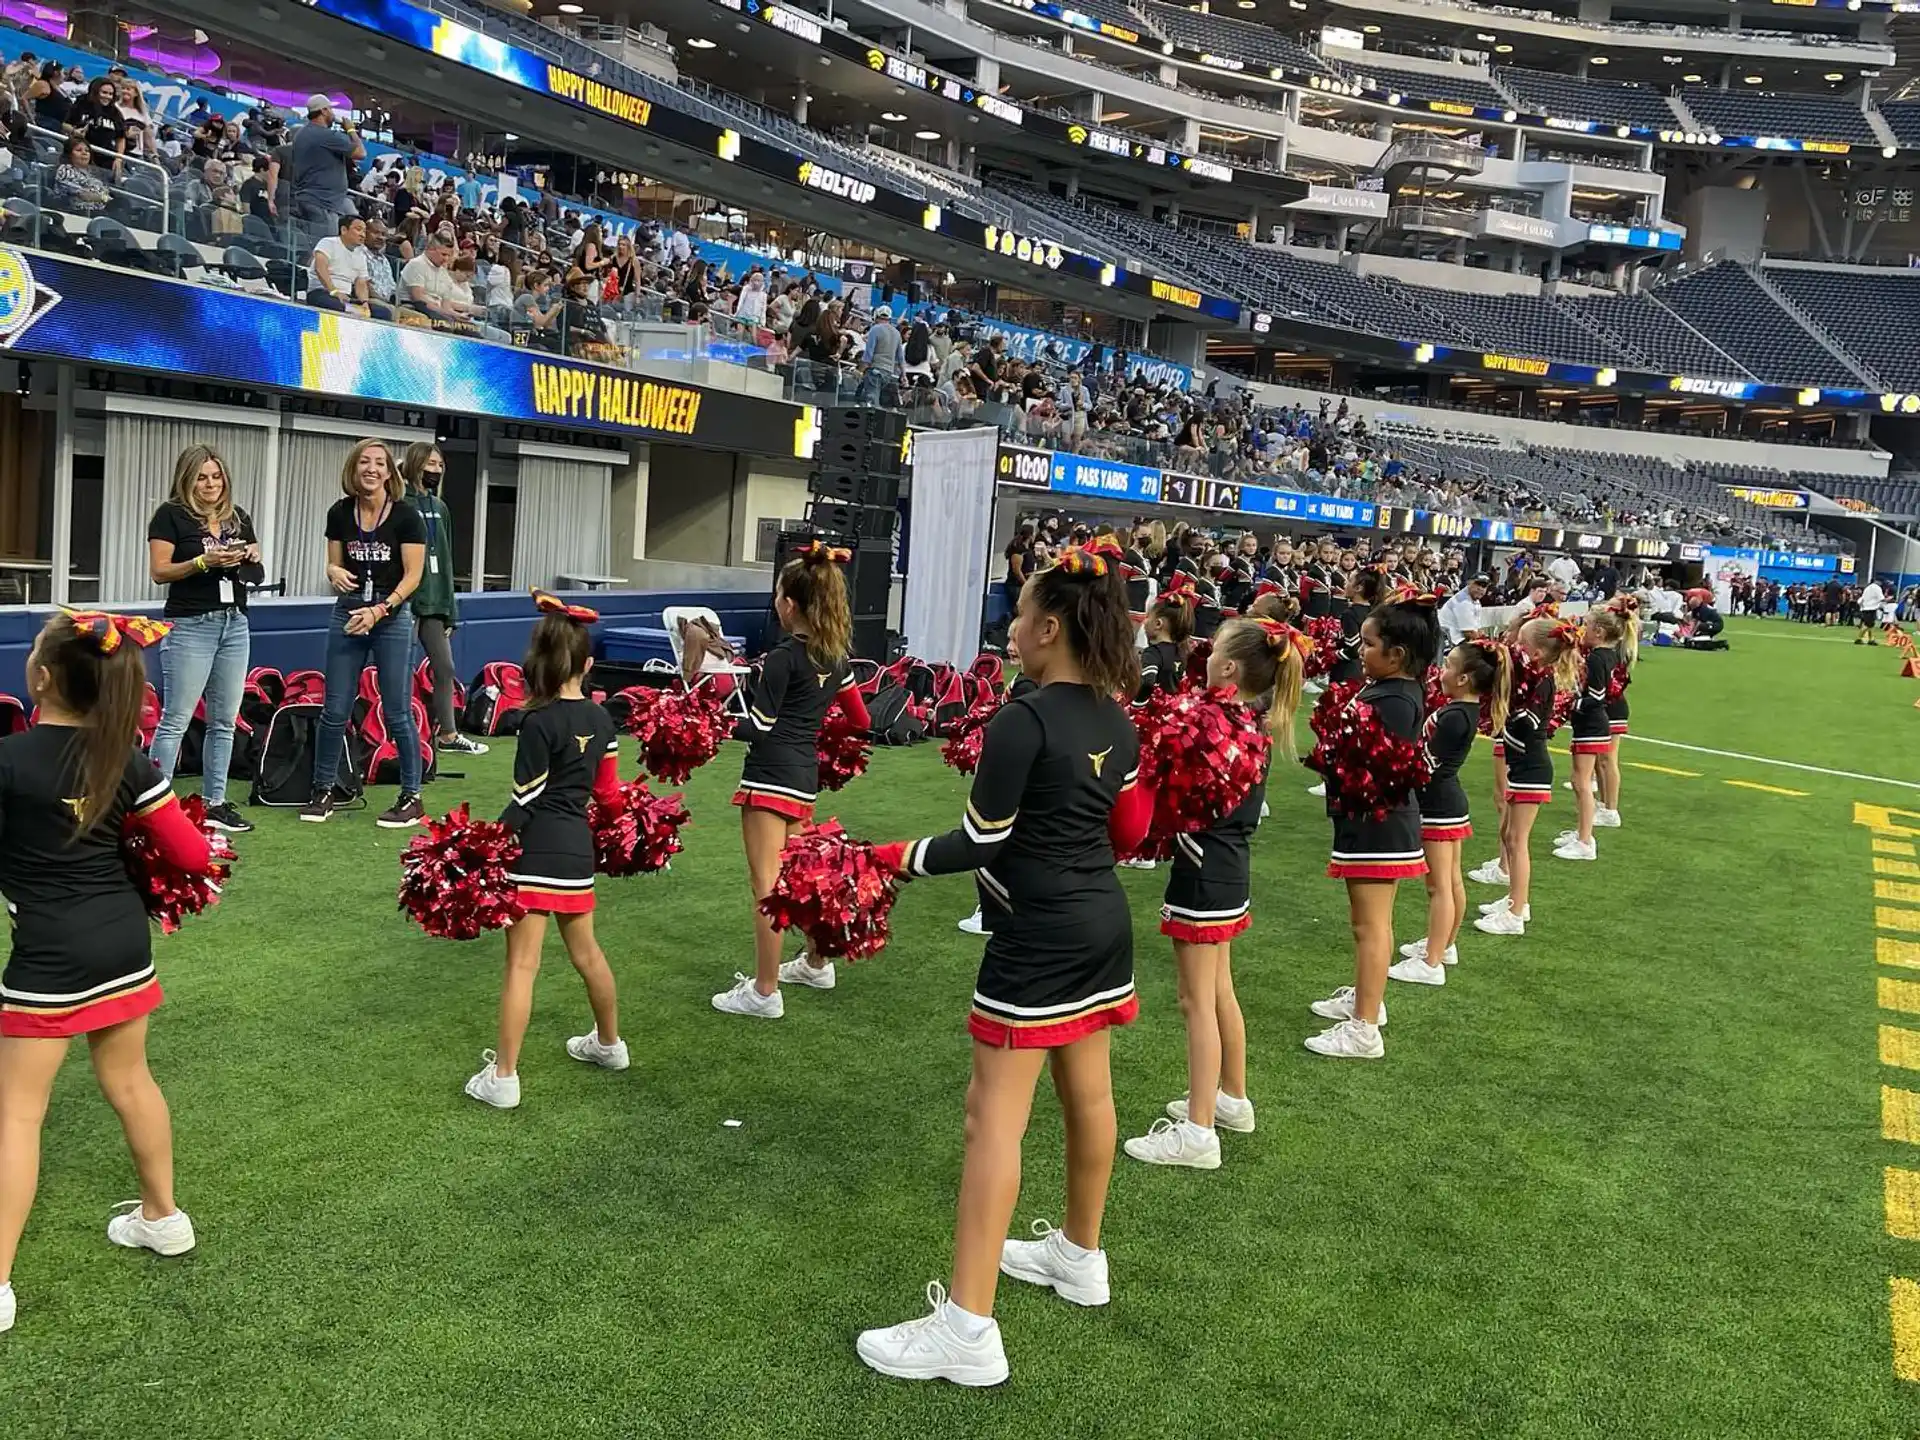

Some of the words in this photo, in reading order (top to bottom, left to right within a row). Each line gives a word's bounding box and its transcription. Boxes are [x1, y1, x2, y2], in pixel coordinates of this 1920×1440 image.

[547, 64, 585, 102] HAPPY
[586, 80, 652, 126] HALLOWEEN
[799, 162, 876, 203] #BOLTUP
[1483, 353, 1508, 370] HAPPY
[1508, 357, 1551, 376] HALLOWEEN
[532, 362, 596, 419] HAPPY
[599, 375, 701, 435] HALLOWEEN
[1670, 375, 1744, 396] #BOLTUP
[1015, 453, 1049, 483] 10:00
[1076, 465, 1100, 488] PASS
[1100, 469, 1130, 492] YARDS
